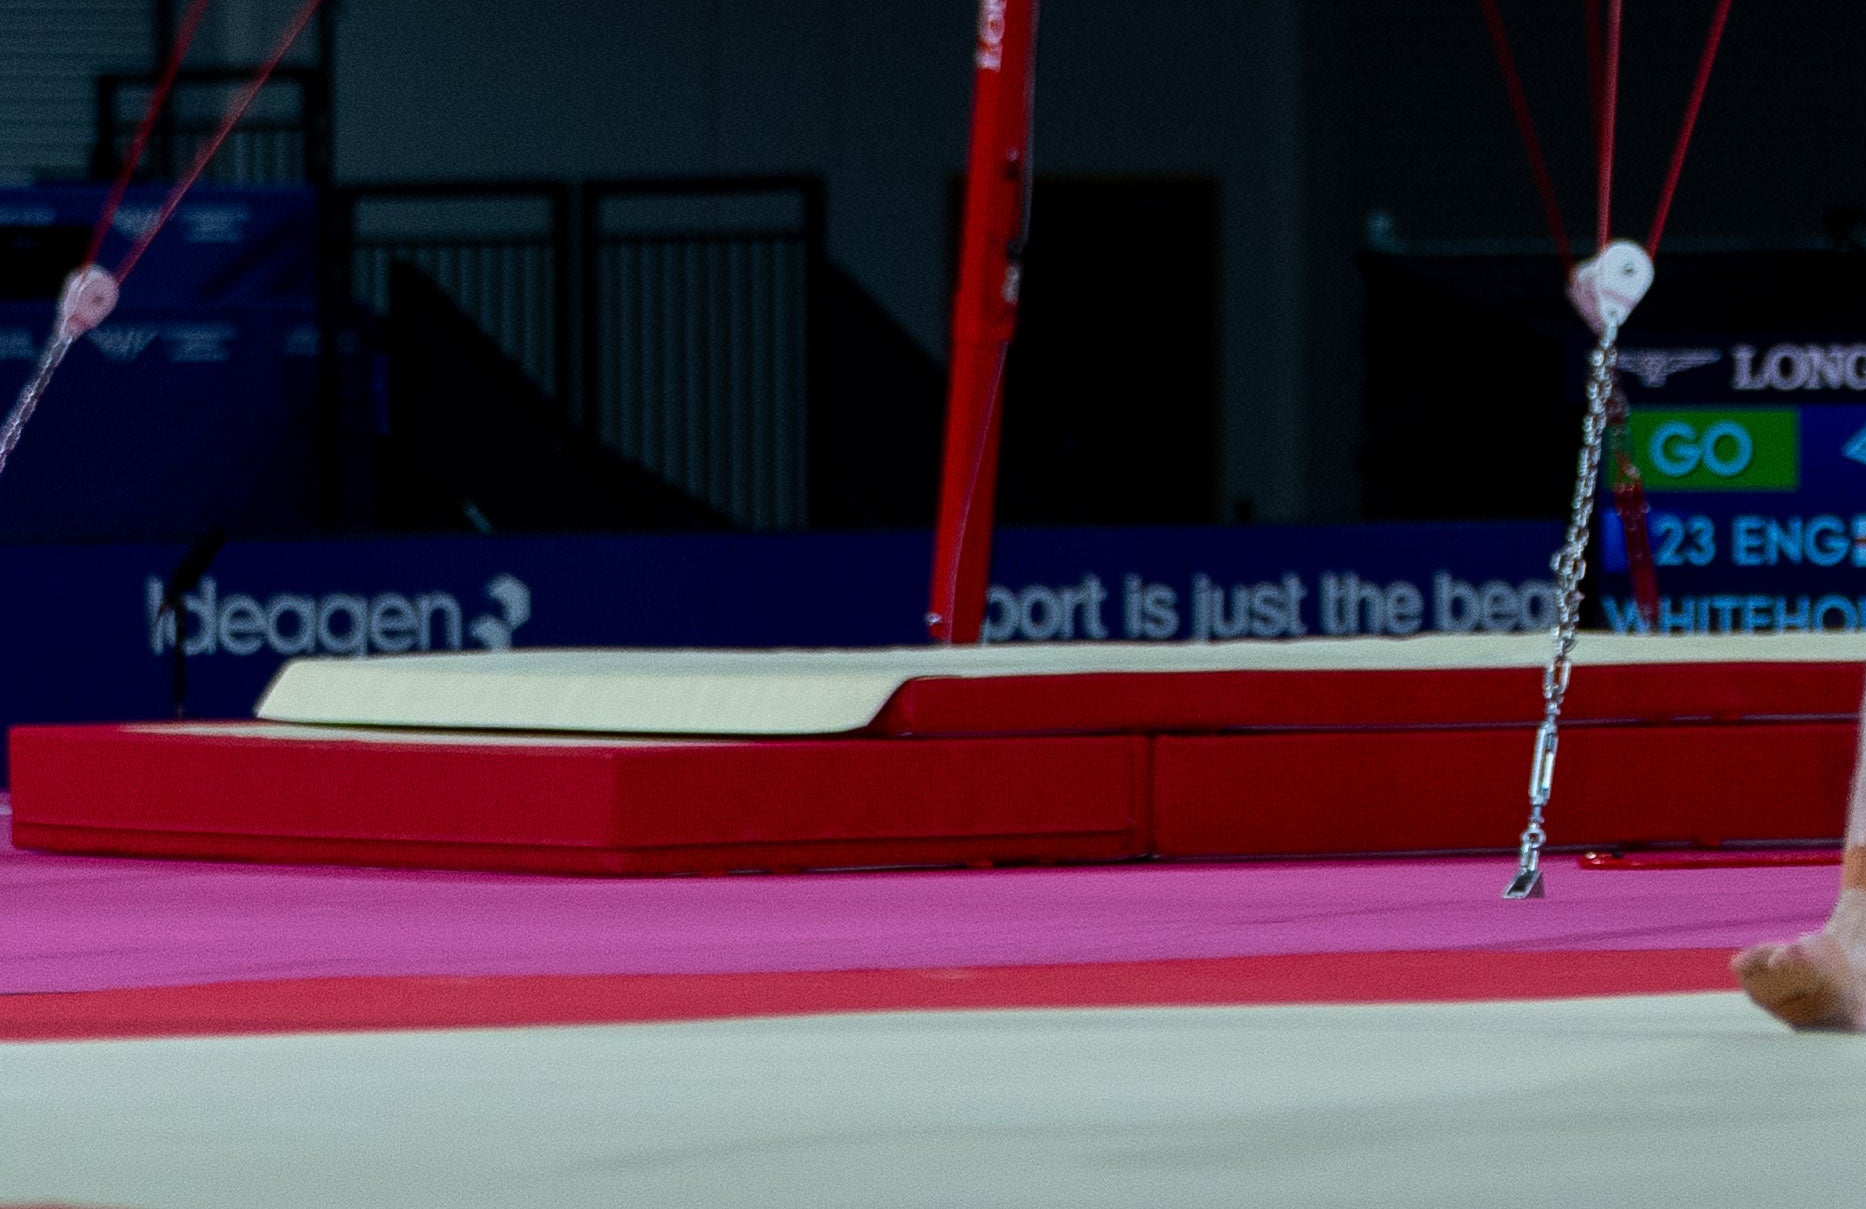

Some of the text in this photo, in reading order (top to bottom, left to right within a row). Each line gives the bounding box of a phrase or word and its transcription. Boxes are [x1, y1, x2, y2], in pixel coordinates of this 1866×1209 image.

[1647, 418, 1755, 478] GO
[1650, 514, 1852, 568] 23 ENG
[1122, 571, 1180, 640] is
[1190, 569, 1311, 642] just
[1318, 569, 1425, 635] the
